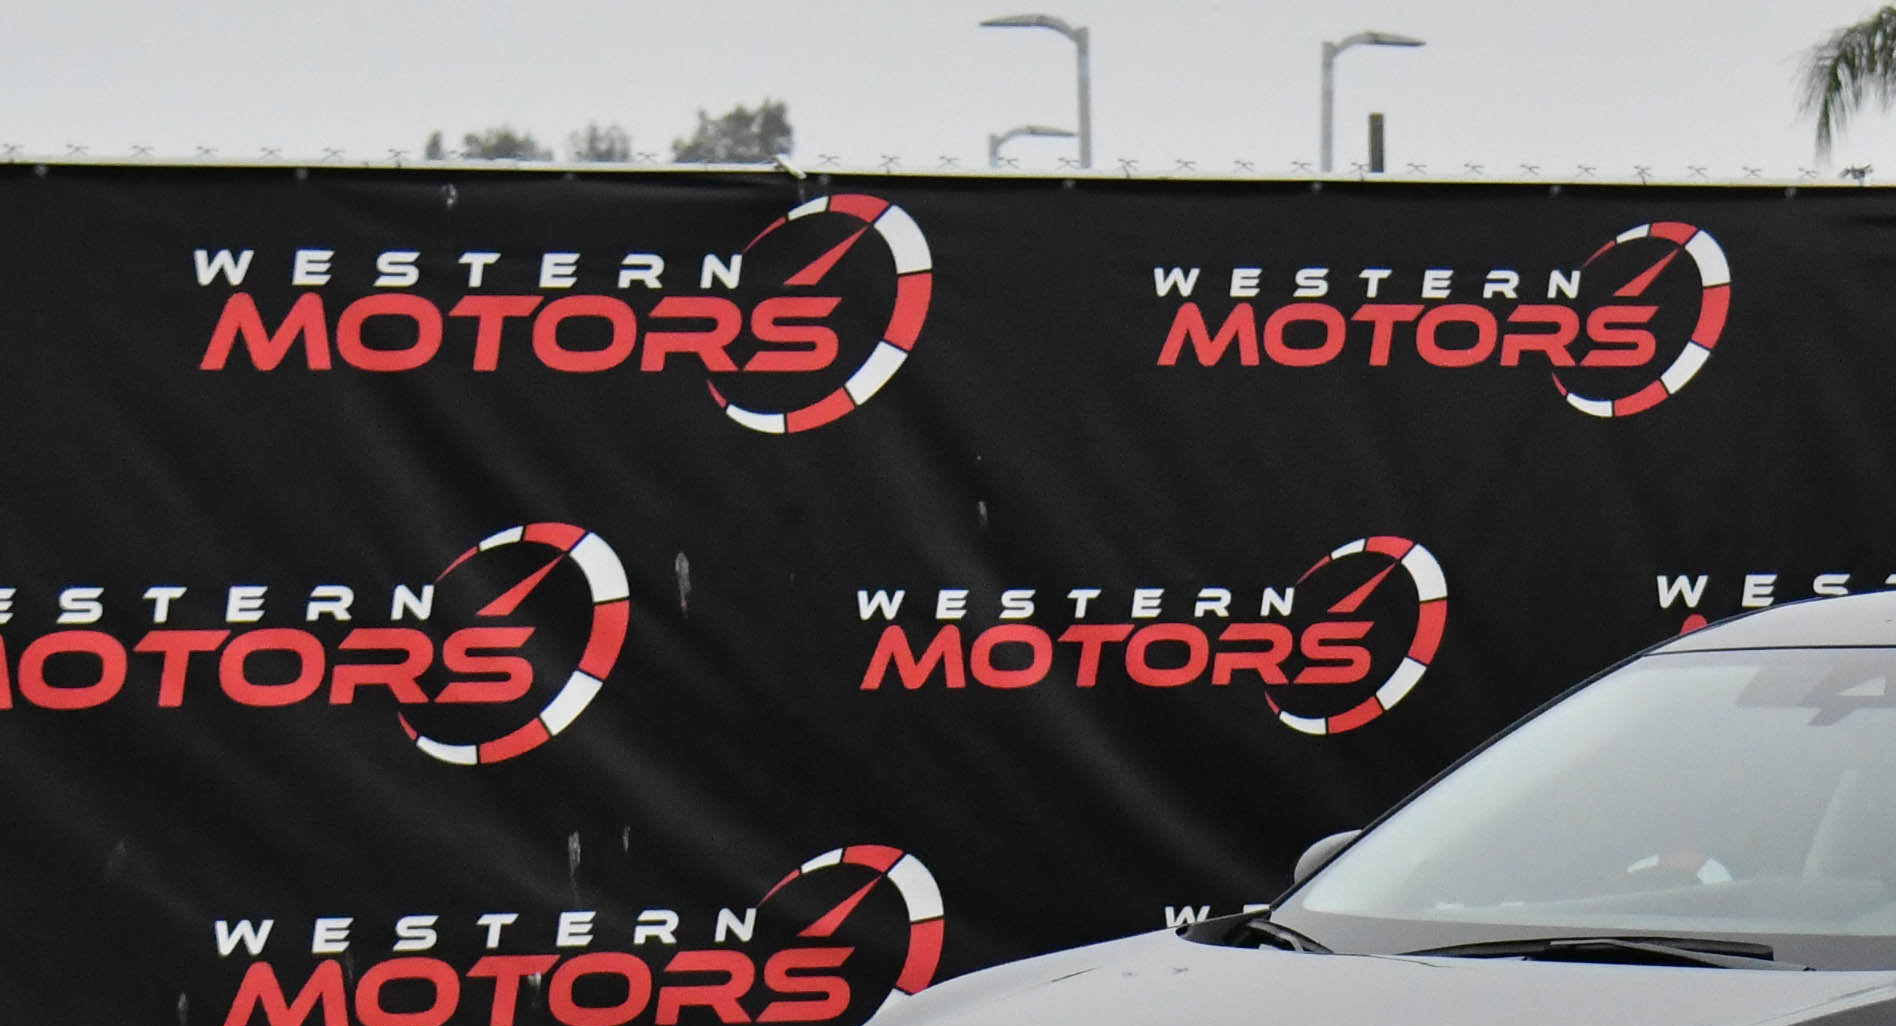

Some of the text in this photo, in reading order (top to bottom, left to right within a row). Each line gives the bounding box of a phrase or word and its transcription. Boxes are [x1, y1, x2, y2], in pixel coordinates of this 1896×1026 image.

[195, 249, 743, 290] WESTERN
[1153, 267, 1582, 299] WESTERN
[200, 292, 842, 373] MOTORS
[1157, 301, 1659, 368] MOTORS
[857, 587, 1296, 621] WESTERN
[0, 628, 536, 711] OTORS
[860, 622, 1374, 691] MOTORS
[214, 907, 758, 956] WESTERN
